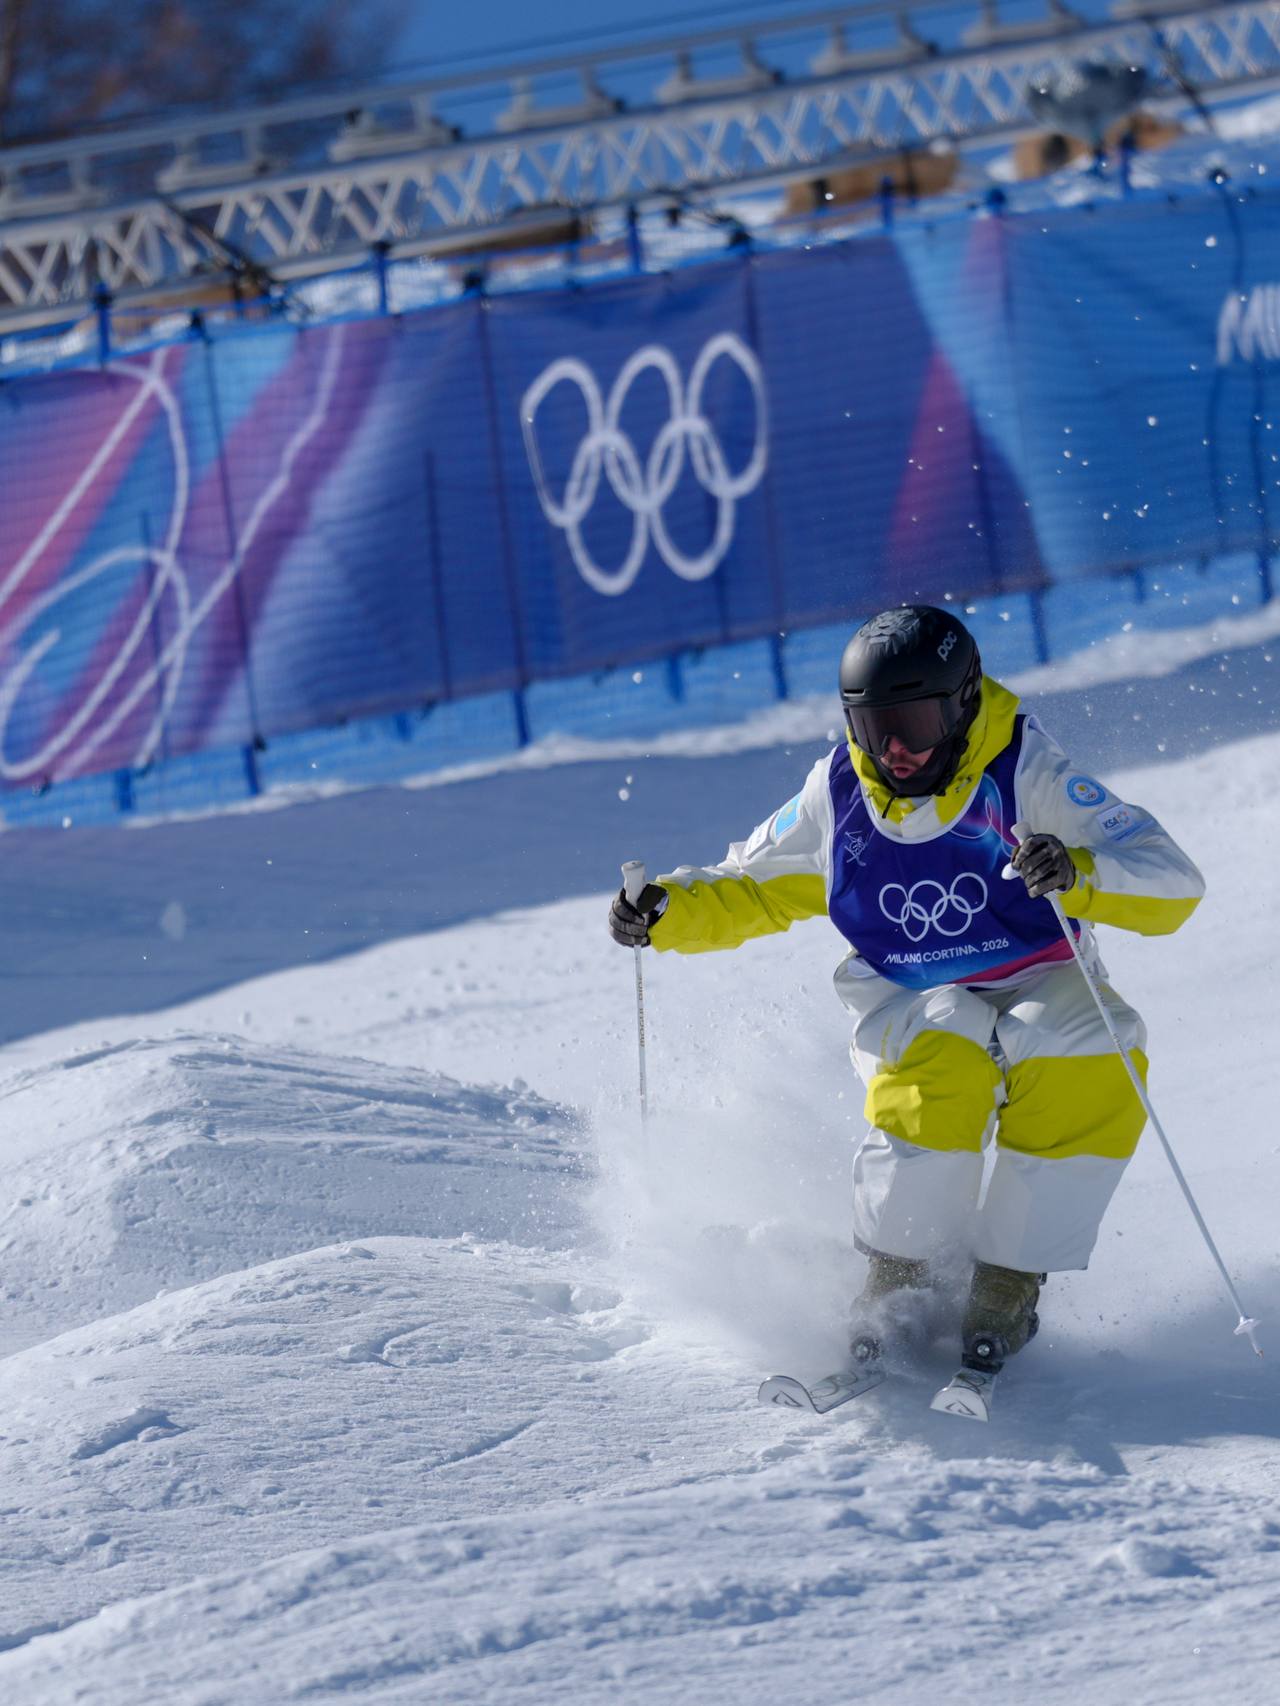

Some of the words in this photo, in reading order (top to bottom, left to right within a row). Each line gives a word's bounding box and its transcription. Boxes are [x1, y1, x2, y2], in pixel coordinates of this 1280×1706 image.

[883, 952, 922, 964] MILANO
[923, 944, 980, 963] CORTINA
[982, 937, 1009, 952] 2026
